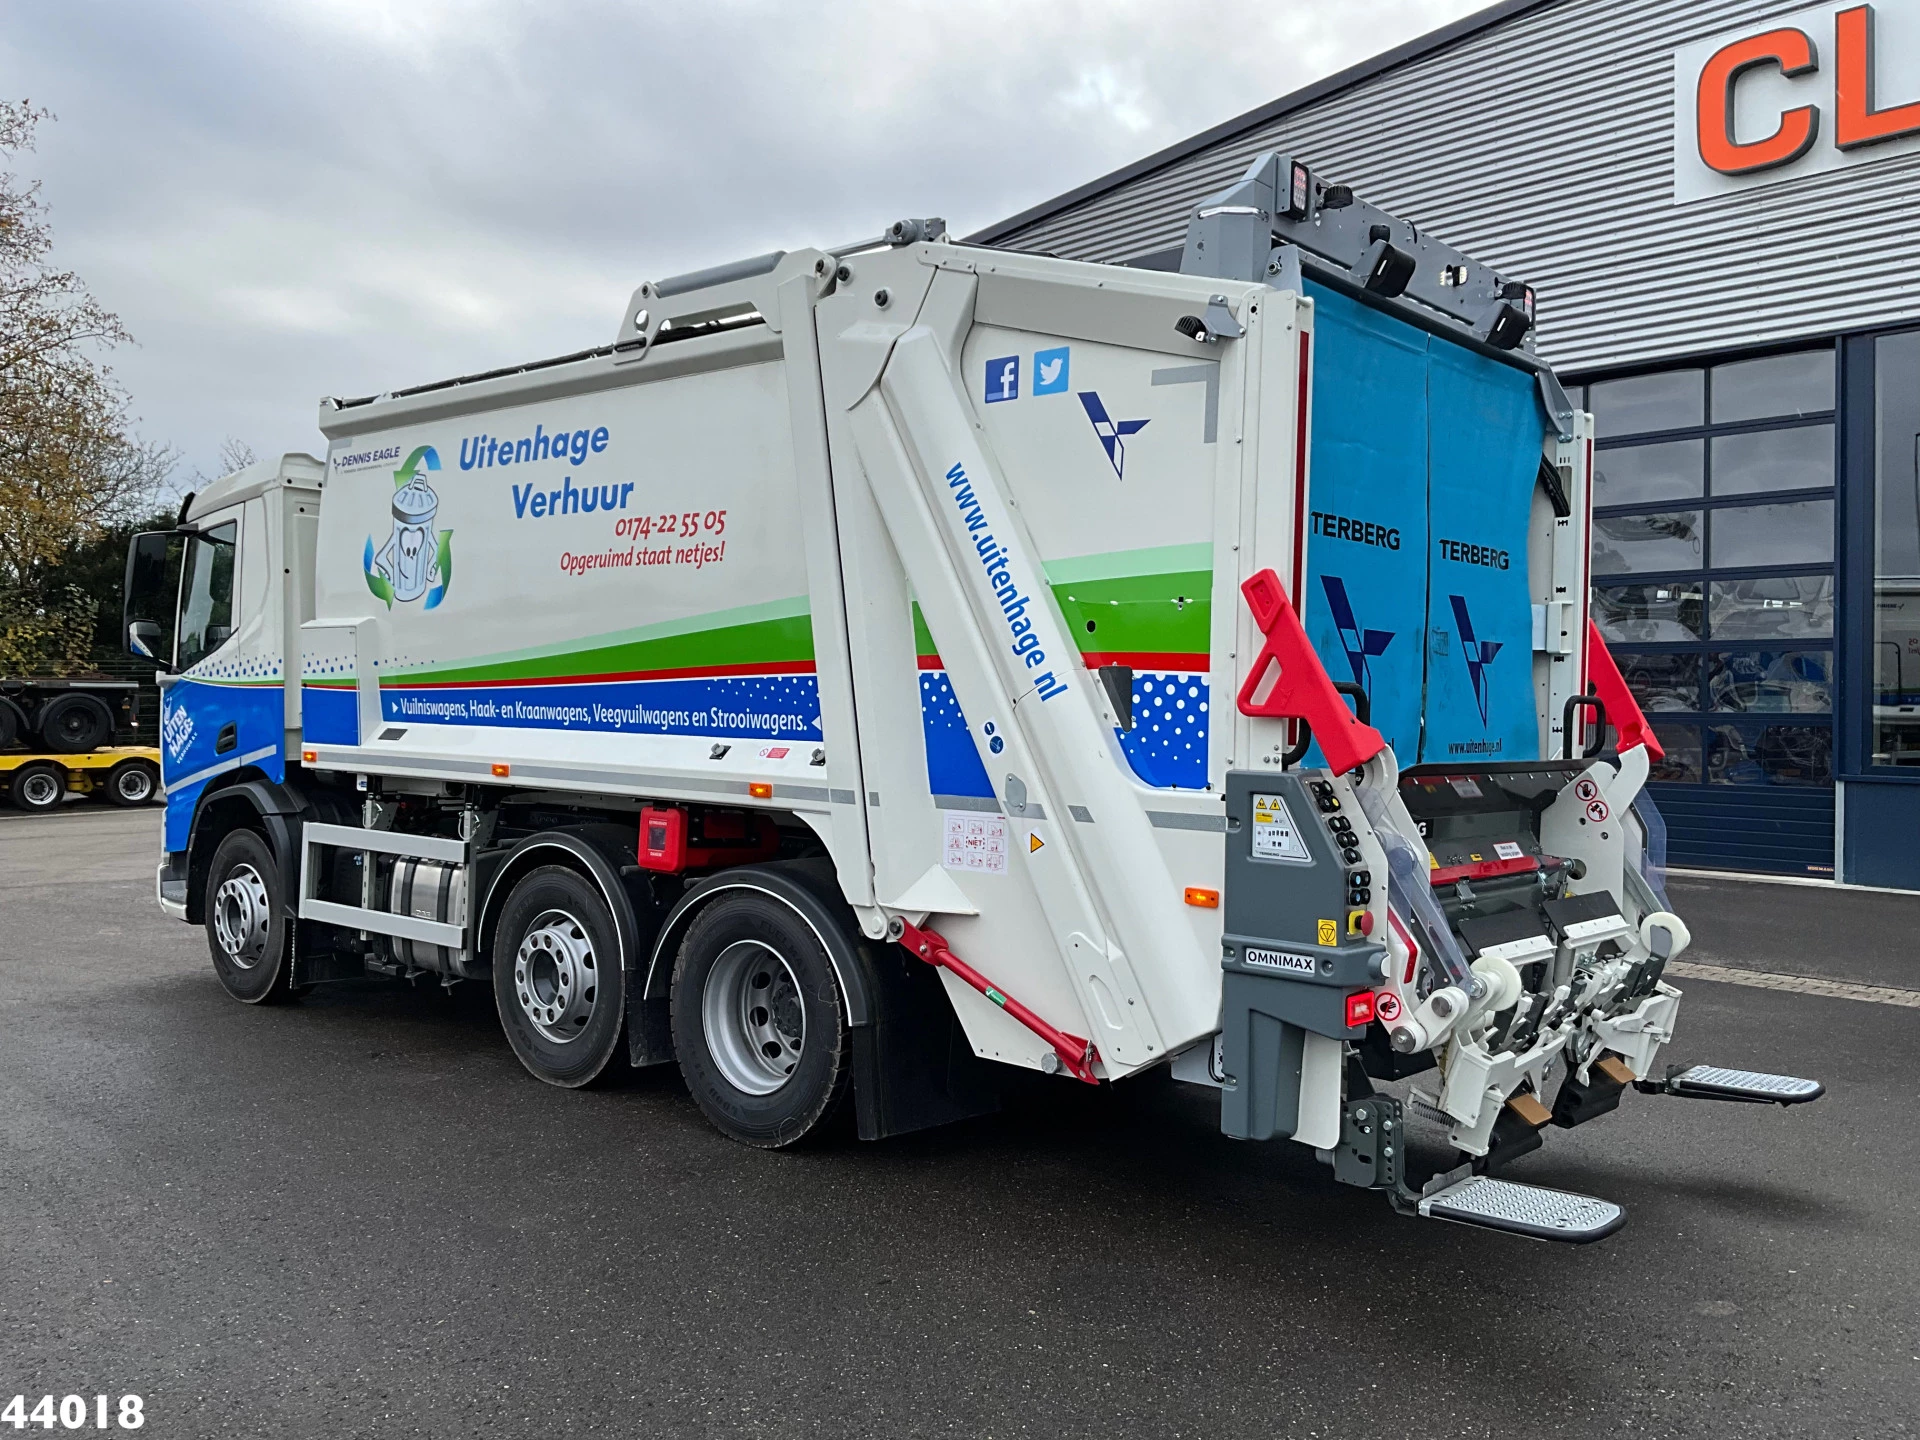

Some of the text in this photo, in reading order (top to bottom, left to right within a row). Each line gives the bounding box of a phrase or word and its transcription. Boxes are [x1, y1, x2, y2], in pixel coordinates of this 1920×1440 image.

[342, 446, 400, 467] DENNIS EAGLE
[459, 424, 610, 471] Uitenhage
[511, 476, 634, 519] Verhuur
[615, 510, 727, 540] 0174-22 55 05
[1310, 511, 1400, 550] TERBERG
[560, 541, 727, 576] Opgeruimd staat netjes!
[1439, 538, 1510, 570] TERBERG
[164, 704, 188, 744] UITEN
[400, 697, 808, 735] Vuilniswagens, Haak- en Kraanwagens, Veegvuilwagens en Strooiwagens.
[169, 718, 193, 758] HAGE
[1448, 738, 1502, 756] www.uitenhage.nl
[967, 839, 982, 847] NIET
[1248, 951, 1312, 971] OMNIMAX
